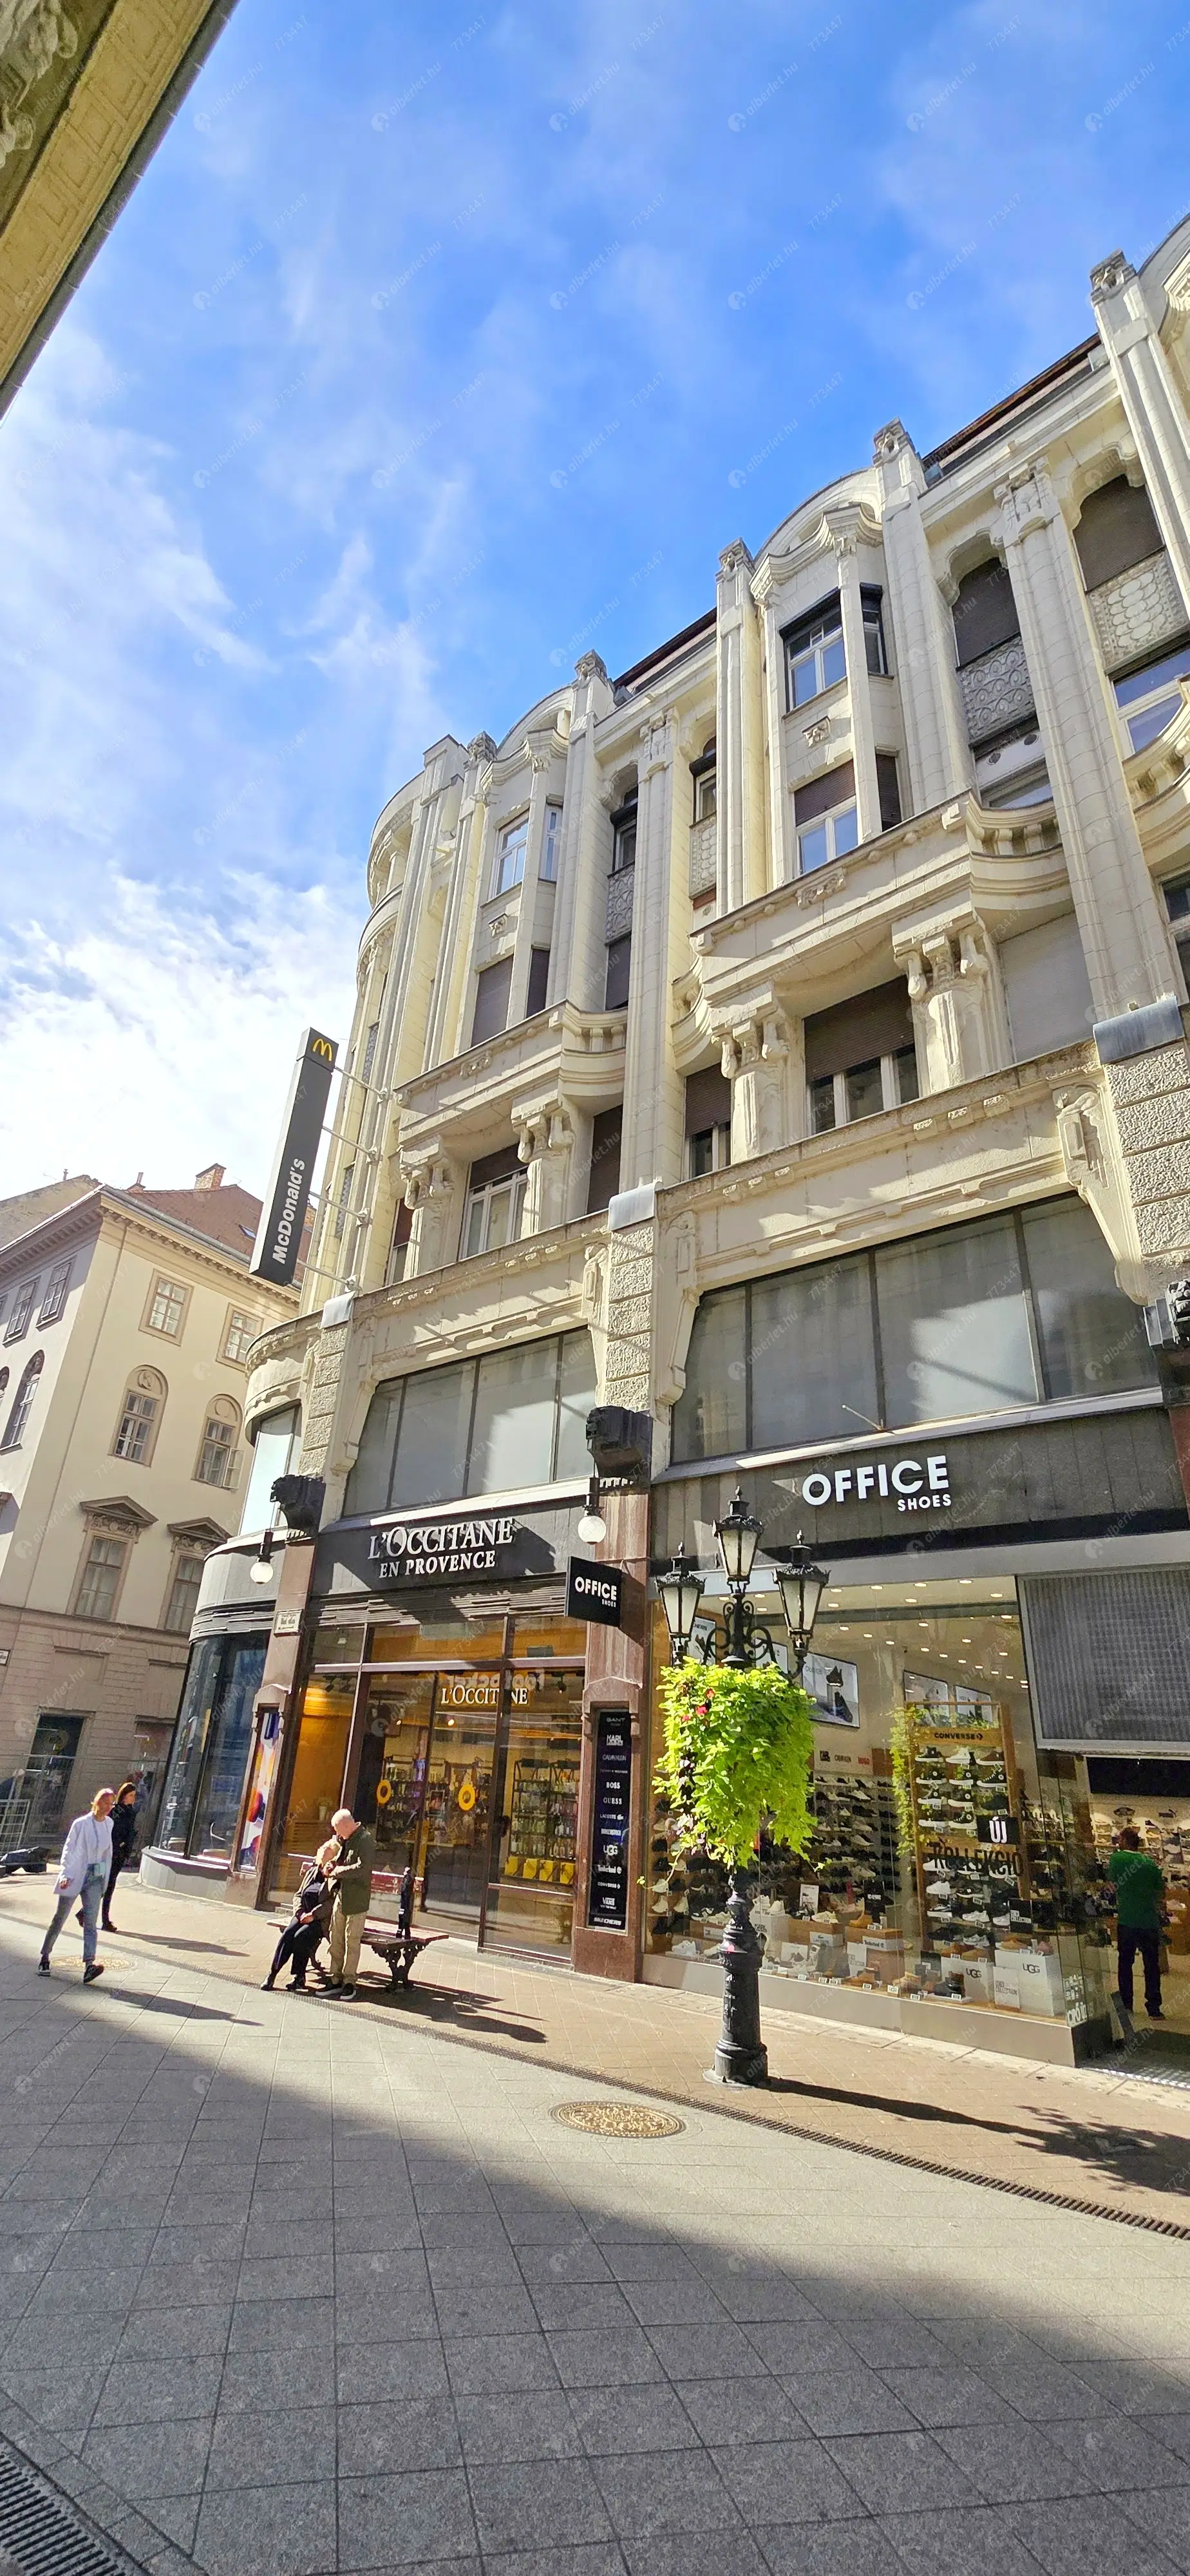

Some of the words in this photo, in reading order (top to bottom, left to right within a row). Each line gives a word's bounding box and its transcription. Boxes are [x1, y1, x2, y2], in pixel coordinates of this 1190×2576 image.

[272, 1159, 305, 1264] McDonald's
[802, 1455, 949, 1506] OFFICE
[897, 1493, 952, 1512] SHOES
[367, 1517, 514, 1559] L'OCCITANE
[379, 1561, 400, 1578] EN
[404, 1550, 496, 1575] PROVENCE
[574, 1576, 617, 1601] OFFICE
[601, 1598, 616, 1607] SHOES
[440, 1685, 528, 1705] L'OCCITNE
[934, 1732, 975, 1740] CONVERSE
[603, 1797, 622, 1805] GUESS
[988, 1816, 1007, 1844] ÚJ
[603, 1844, 618, 1856] UGG
[966, 1967, 983, 1979] UGG
[1022, 1963, 1041, 1975] UGG
